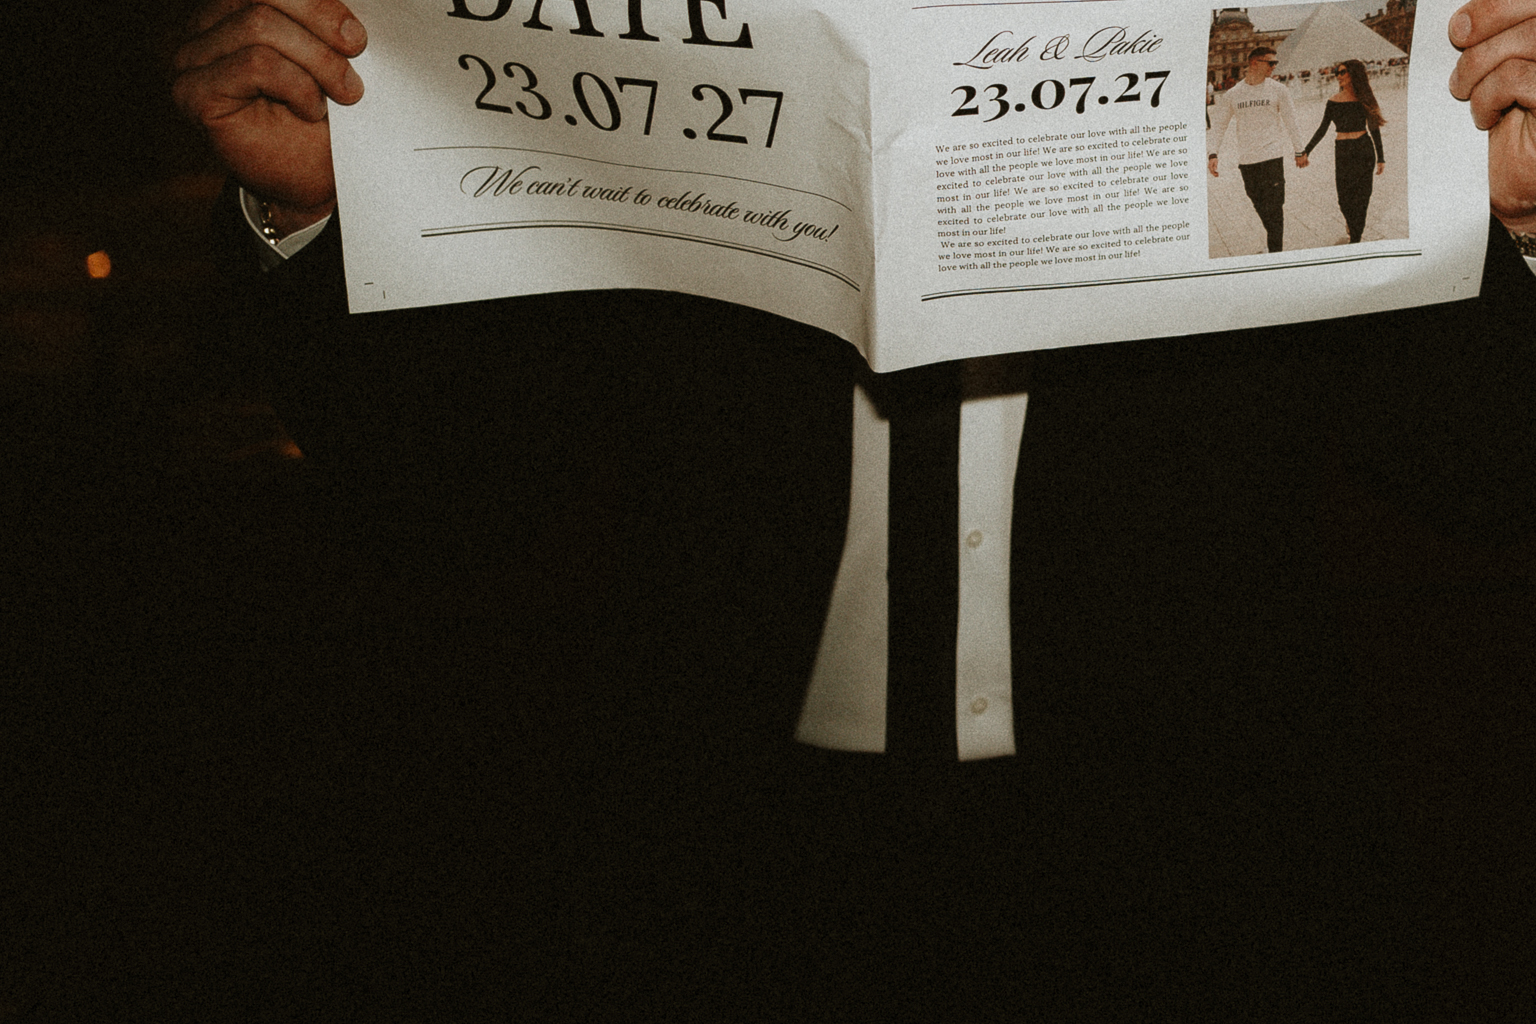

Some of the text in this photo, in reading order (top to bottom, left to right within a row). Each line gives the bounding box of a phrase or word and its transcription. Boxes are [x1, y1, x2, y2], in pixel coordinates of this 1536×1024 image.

[953, 30, 1037, 68] Leah
[1039, 34, 1070, 61] &
[458, 54, 784, 148] 23.07.27
[950, 70, 1171, 123] 23.07.27
[1237, 100, 1271, 109] HILFIGER
[934, 121, 1188, 154] We are so excited to celebrate our love with all the people
[950, 155, 970, 165] love
[971, 152, 994, 163] most
[995, 152, 1005, 160] in
[1005, 150, 1022, 159] our
[1023, 147, 1040, 157] life!
[1042, 146, 1057, 155] We
[1058, 145, 1073, 153] are
[1074, 144, 1086, 153] so
[1086, 139, 1119, 151] excited
[1120, 140, 1130, 148] to
[1131, 136, 1171, 147] celebrate
[1172, 135, 1187, 143] our
[460, 166, 839, 242] We can't wait to celebrate with you!
[937, 226, 1007, 238] most in our life!
[937, 253, 951, 261] we
[952, 251, 972, 260] love
[973, 250, 996, 259] most
[998, 250, 1008, 258] in
[1008, 249, 1025, 257] our
[1026, 246, 1044, 255] life!
[1045, 245, 1060, 254] We
[1061, 245, 1076, 253] are
[1090, 238, 1122, 250] excited
[1134, 235, 1174, 246] celebrate
